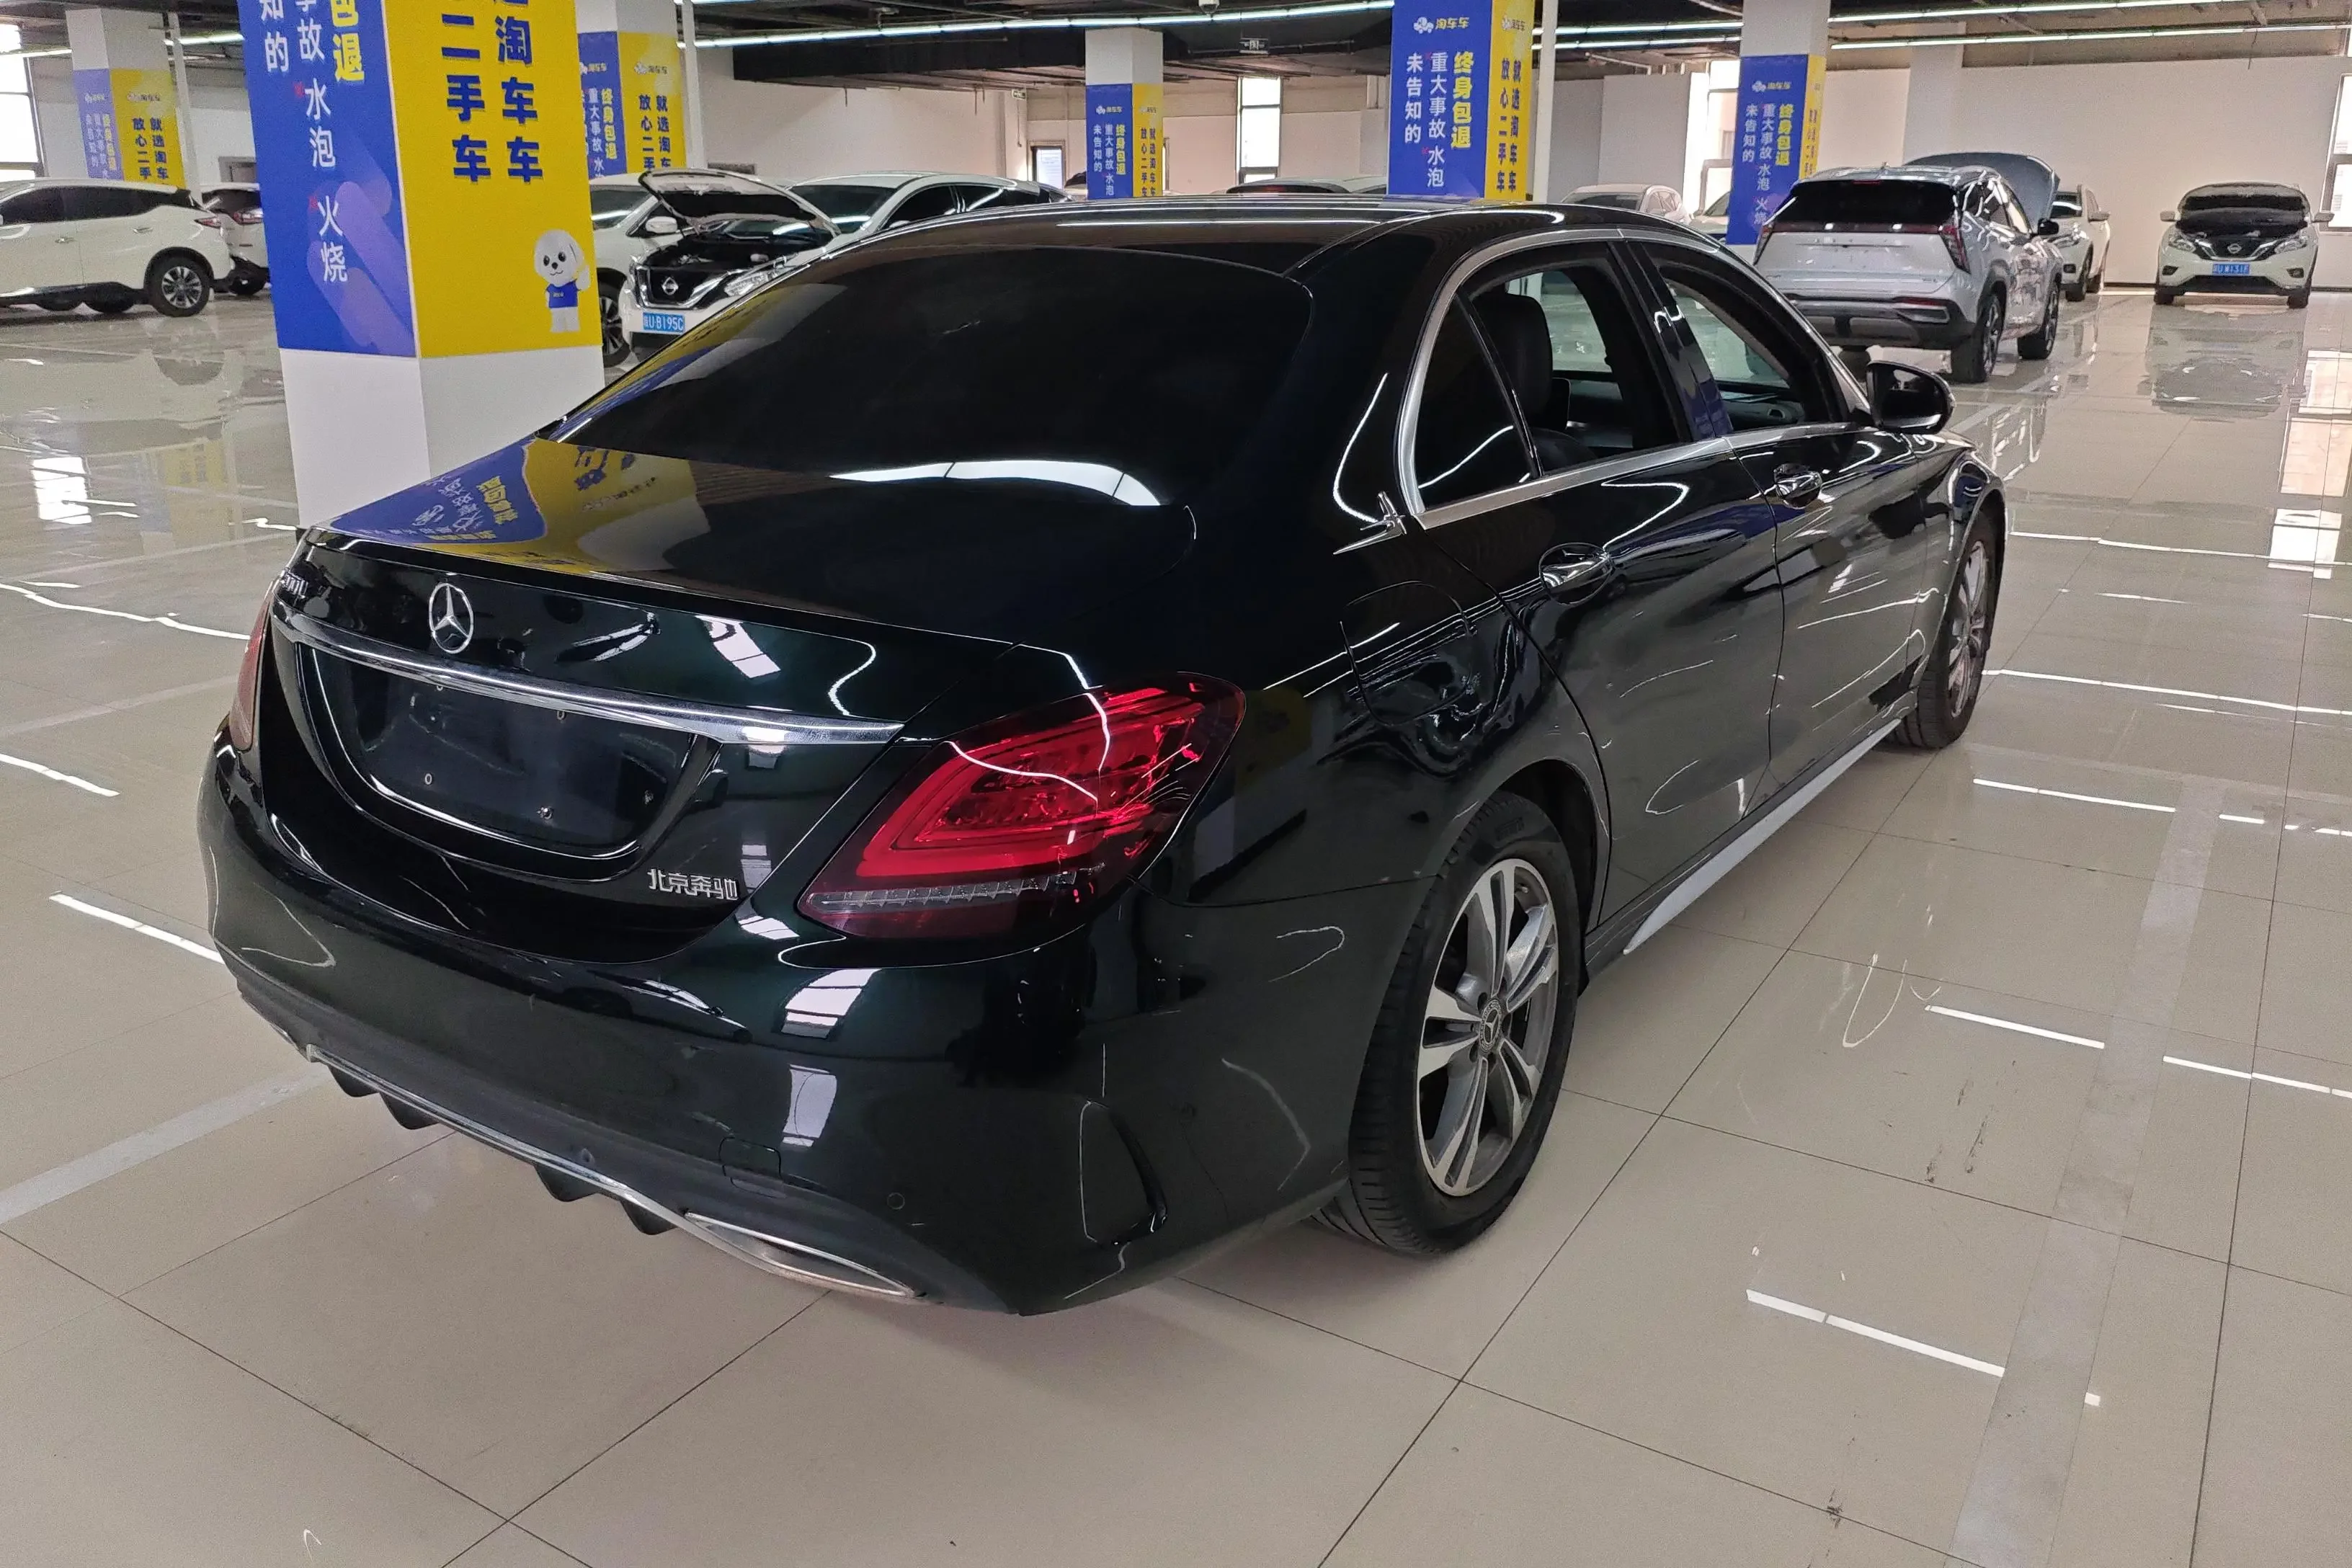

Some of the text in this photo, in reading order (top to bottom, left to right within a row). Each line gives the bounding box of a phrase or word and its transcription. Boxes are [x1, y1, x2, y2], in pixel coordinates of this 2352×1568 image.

[1435, 17, 1469, 30] 淘车车
[441, 13, 491, 182] 二手车
[493, 0, 543, 182] 淘车车
[588, 87, 603, 153] 重大事故
[601, 87, 617, 160] 终身包退
[1404, 53, 1423, 143] 未告知的
[1427, 52, 1448, 187] 重大事故 水泡
[1451, 51, 1474, 149] 终身包退
[1496, 58, 1510, 192] 放心二手车
[1508, 60, 1522, 192] 就选淘车车
[295, 0, 348, 282] 故 水泡 火烧
[1093, 124, 1102, 172] 未告知的
[1105, 124, 1115, 196] 重大事故 水泡
[1116, 124, 1126, 175] 终身包退
[1742, 104, 1758, 163] 未告知的
[1759, 104, 1776, 160] 重大事故
[1775, 104, 1794, 166] 终身包退
[647, 868, 739, 901] 北京奔驰
